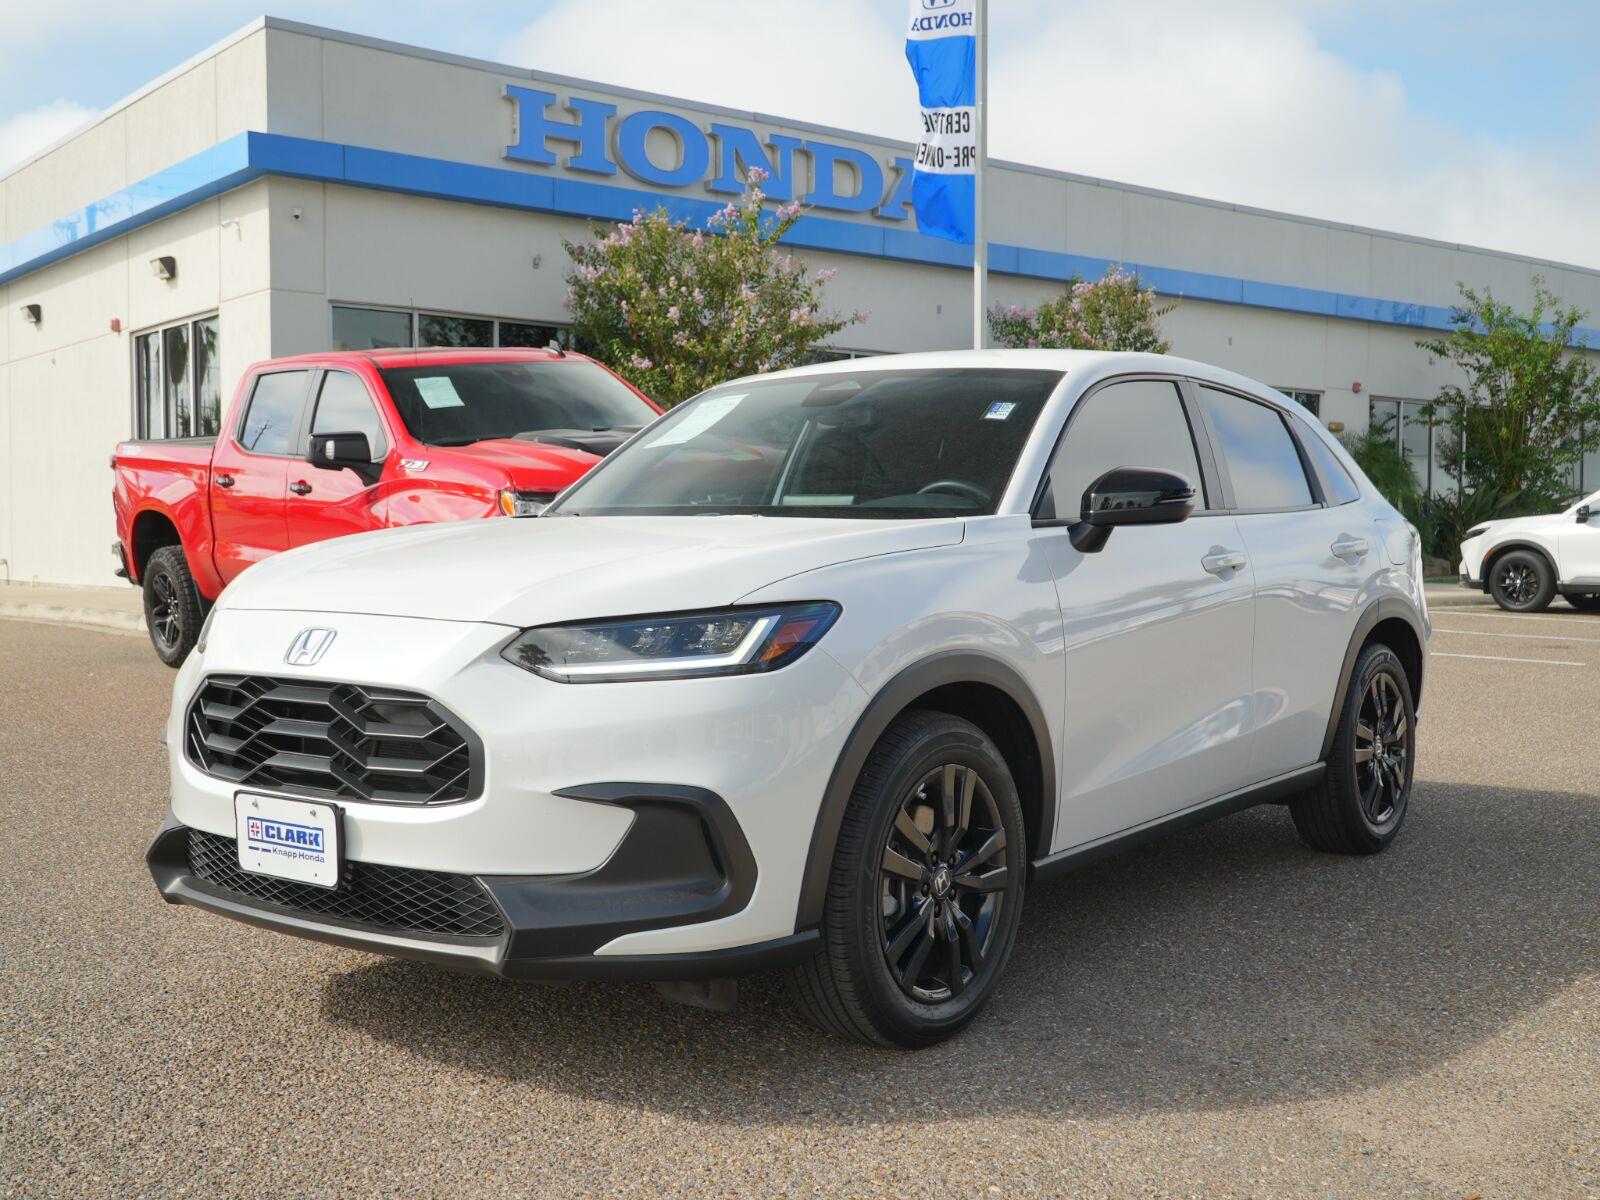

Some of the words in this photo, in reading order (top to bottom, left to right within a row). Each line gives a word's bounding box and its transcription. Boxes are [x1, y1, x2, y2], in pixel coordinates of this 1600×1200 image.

[264, 825, 321, 847] CLARK
[272, 847, 298, 859] Knapp
[298, 852, 325, 863] Honda
